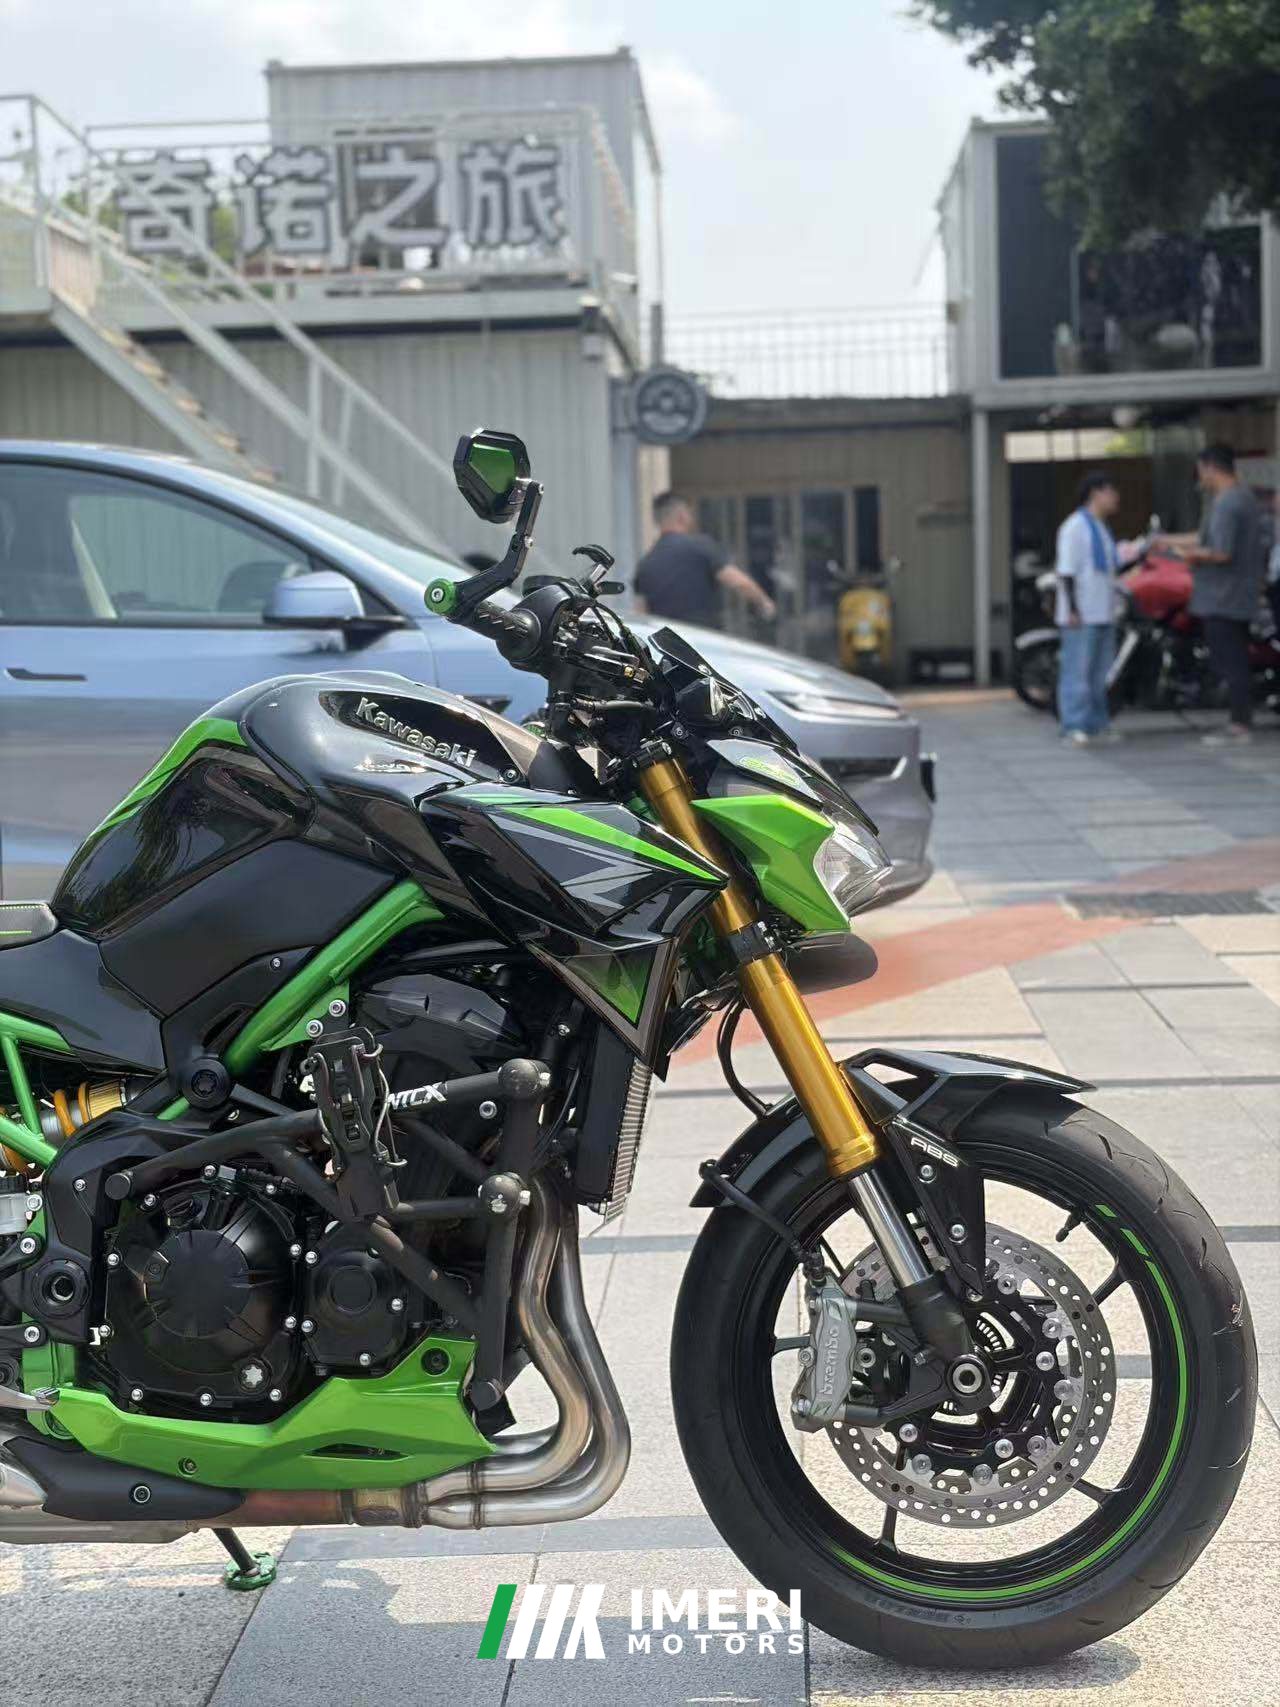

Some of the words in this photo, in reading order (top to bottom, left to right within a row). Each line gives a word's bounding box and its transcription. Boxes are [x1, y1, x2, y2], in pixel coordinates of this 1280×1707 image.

[356, 697, 477, 768] Kawasaki
[911, 1137, 959, 1168] ABS
[819, 1326, 840, 1395] brembo
